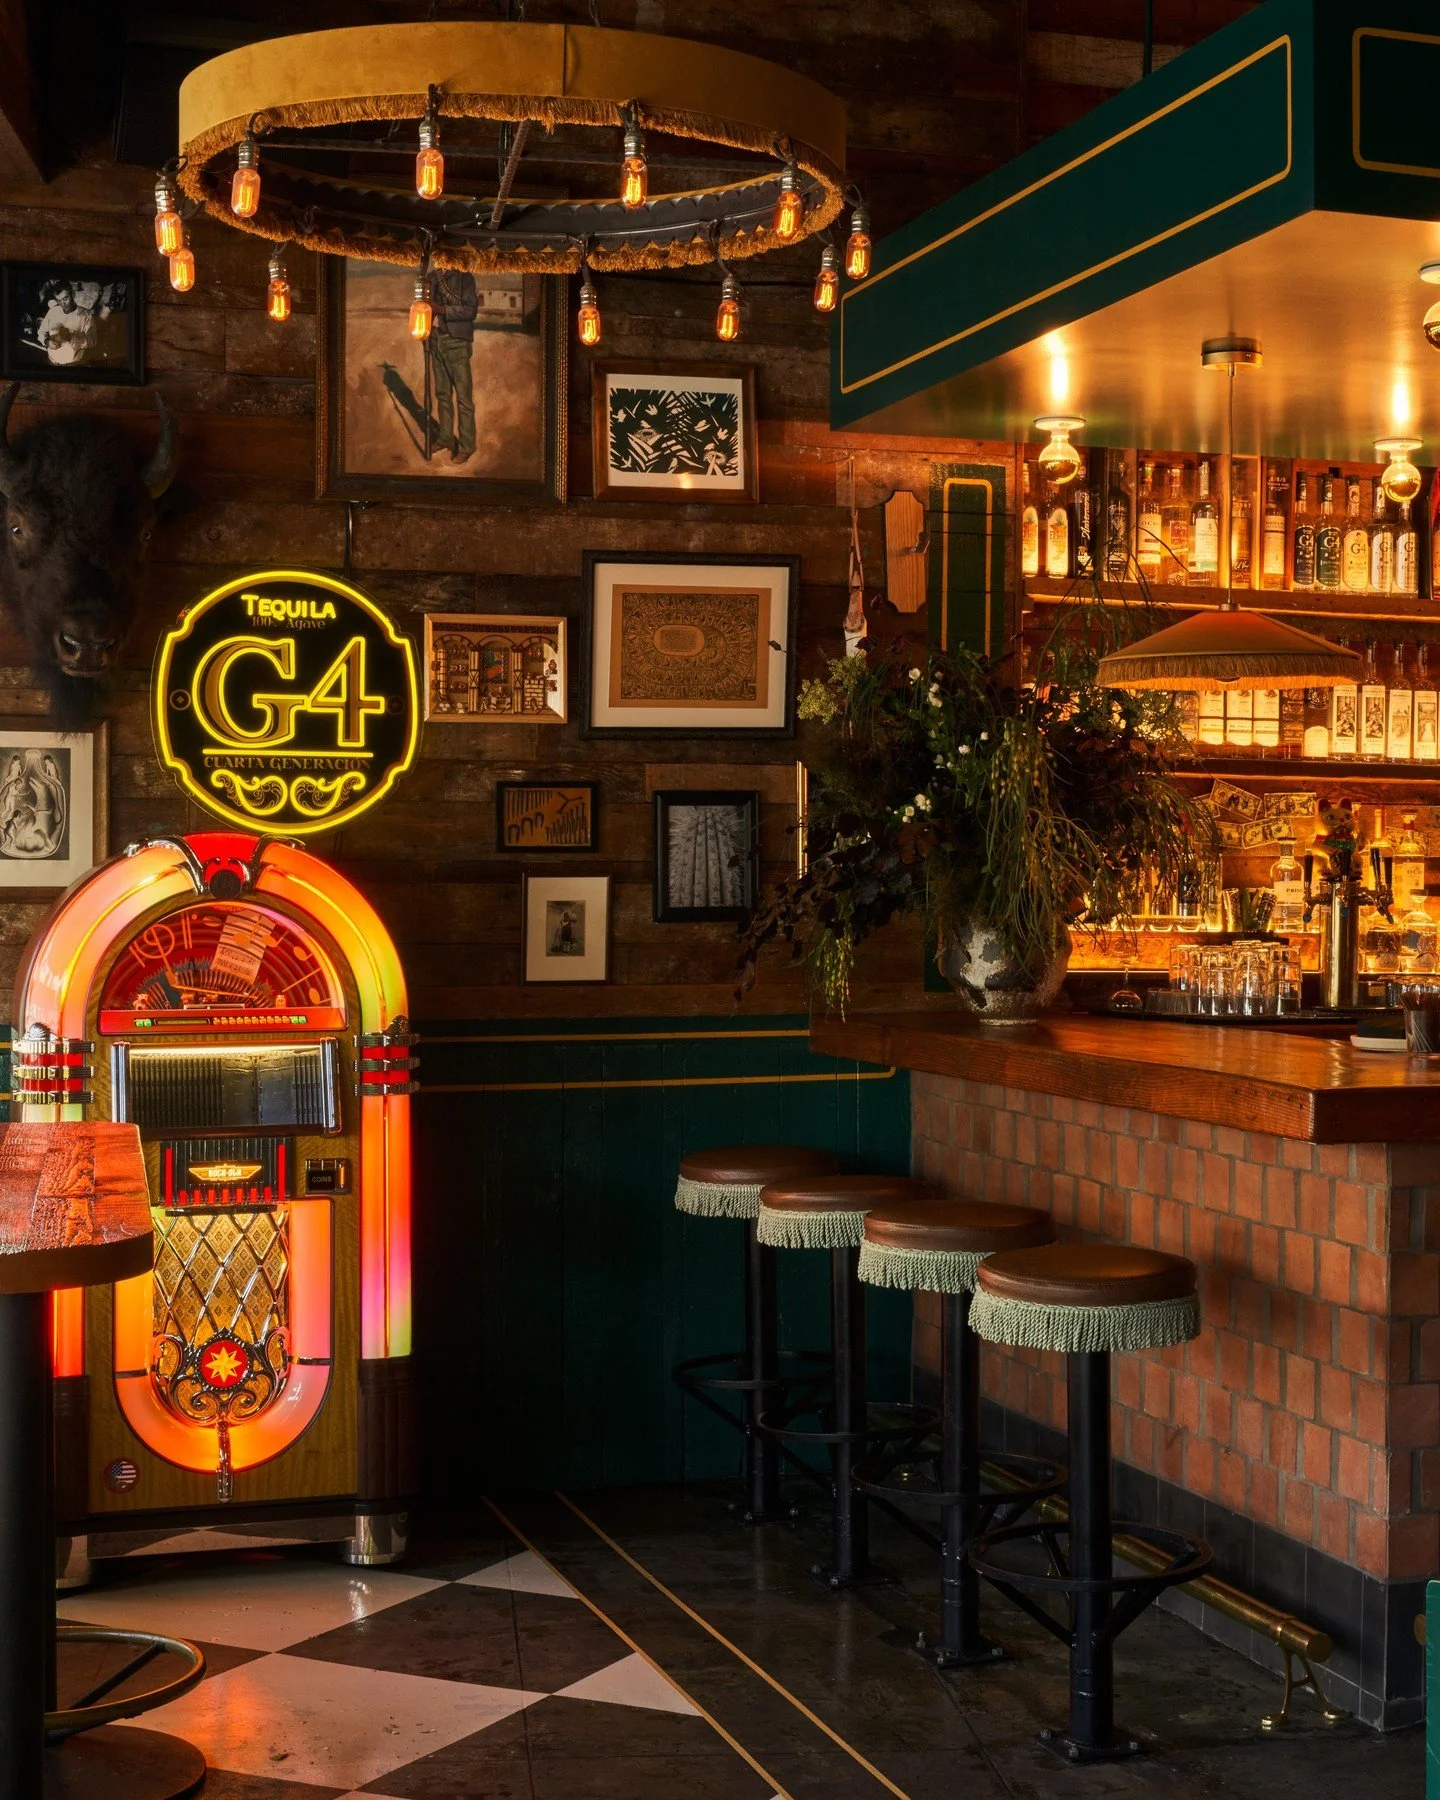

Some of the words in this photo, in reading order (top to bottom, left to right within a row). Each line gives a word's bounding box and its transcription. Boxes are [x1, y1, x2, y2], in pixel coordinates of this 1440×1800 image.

[1324, 536, 1340, 548] G4
[1351, 543, 1367, 555] G4
[241, 594, 337, 620] TEQUILA
[286, 618, 326, 630] Agave
[191, 635, 386, 749] G4
[203, 756, 265, 769] CUARTA
[311, 1175, 332, 1183] COINS
